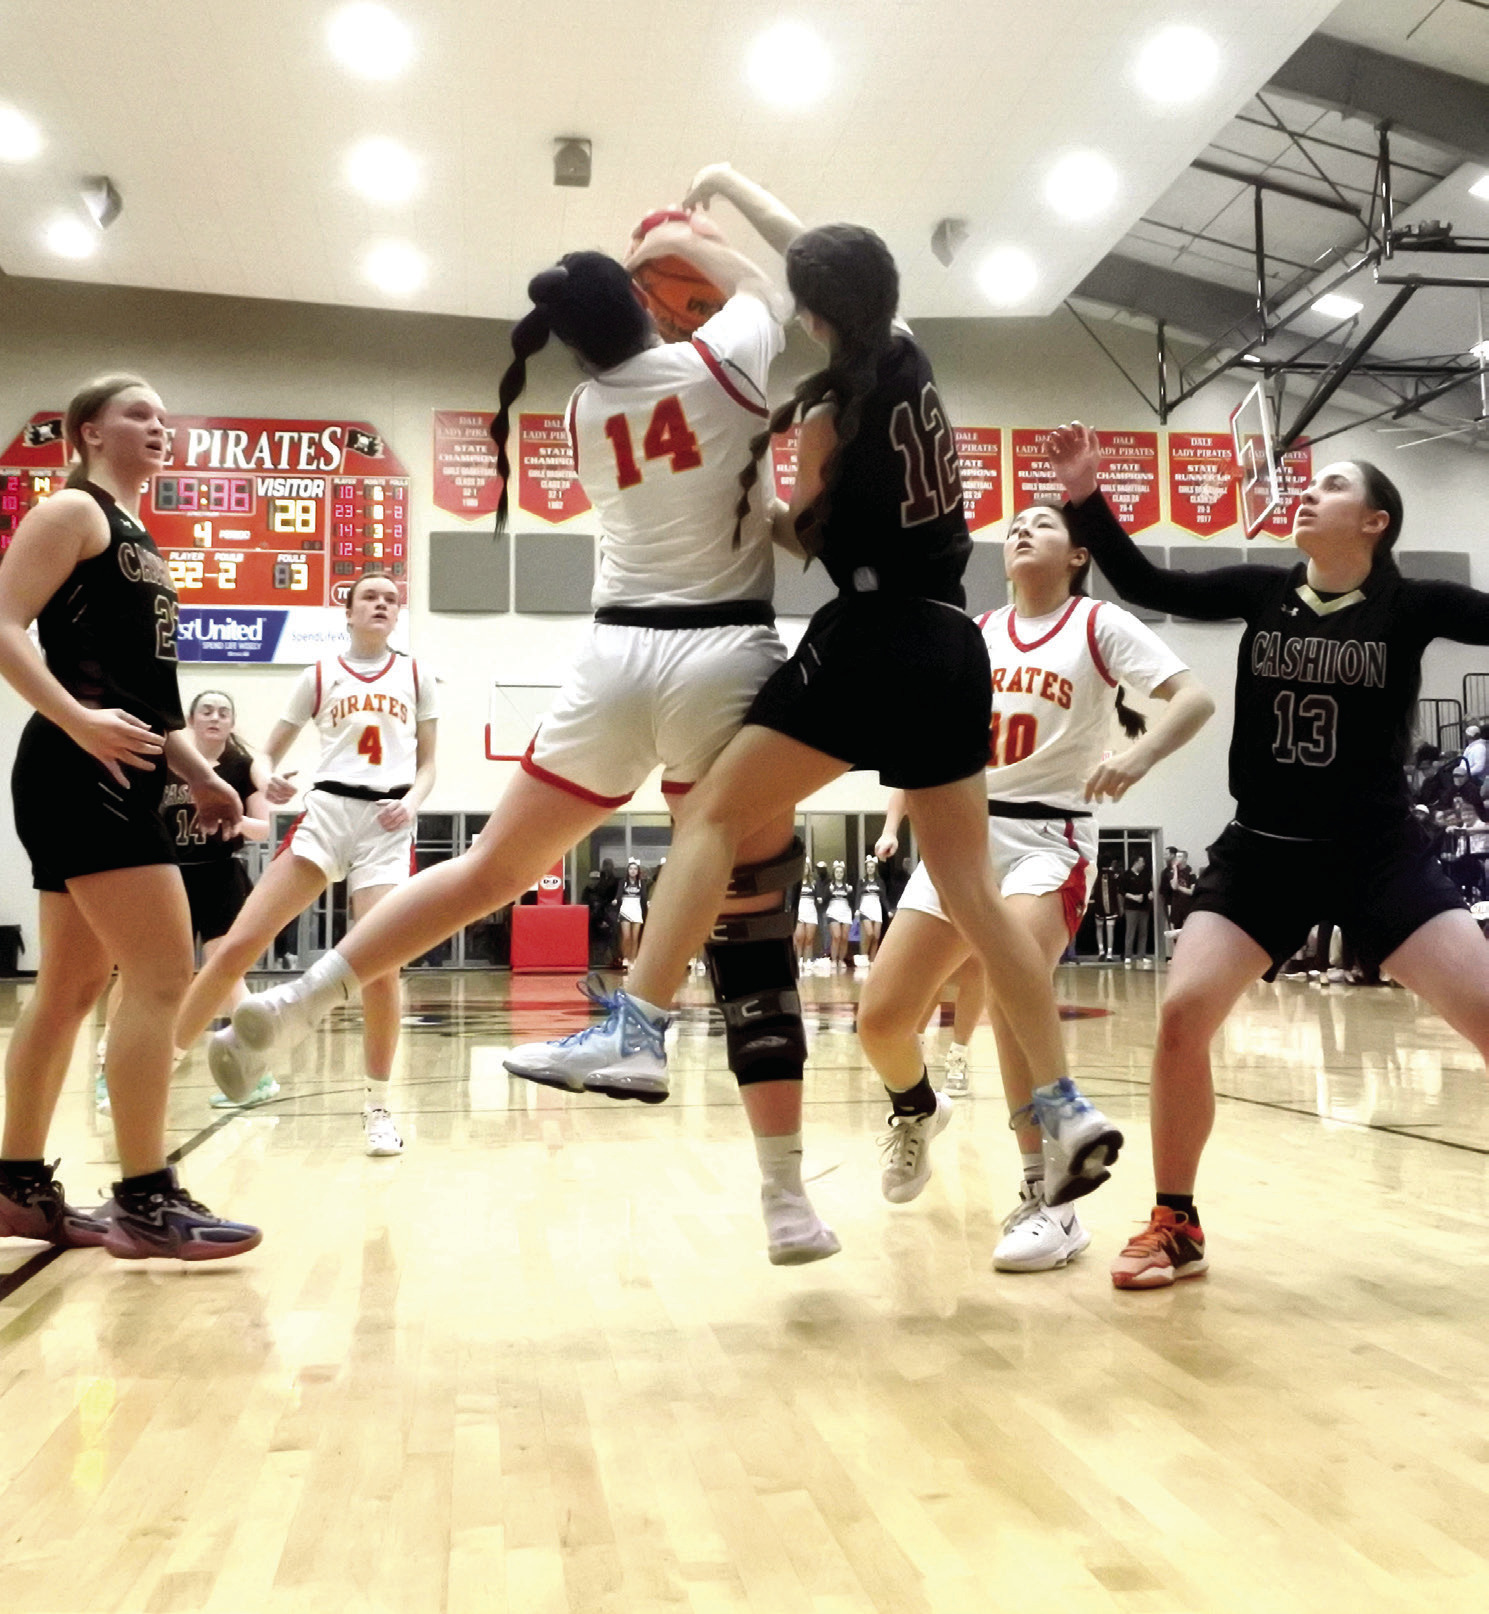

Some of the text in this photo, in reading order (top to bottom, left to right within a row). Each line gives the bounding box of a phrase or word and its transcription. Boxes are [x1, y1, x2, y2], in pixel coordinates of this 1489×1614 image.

[459, 416, 483, 425] DALE
[544, 419, 564, 428] DAL
[465, 428, 488, 437] PIRA
[523, 431, 546, 439] LADY
[956, 432, 978, 440] DALE
[604, 394, 703, 491] 14
[1113, 436, 1135, 445] DALE
[1190, 438, 1213, 446] DALE
[185, 426, 342, 471] PIRATES
[454, 445, 487, 453] STATE
[961, 444, 998, 452] PIRATES
[1016, 445, 1039, 453] LADY
[1100, 447, 1155, 456] ADY PIRATES
[1172, 448, 1232, 457] LADY PIRATES
[439, 455, 498, 463] CHAMPION
[889, 382, 963, 528] 12
[1248, 450, 1265, 458] LAD
[960, 459, 983, 467] TATE
[1031, 461, 1050, 469] STA
[1109, 463, 1140, 471] STATE
[1096, 472, 1154, 480] CHAMPIONS
[257, 478, 325, 498] VISITOR
[340, 486, 353, 498] 10
[274, 499, 317, 533] 28
[335, 505, 353, 518] 23
[194, 521, 212, 548] 4
[340, 524, 353, 537] 14
[374, 523, 384, 538] 3
[340, 543, 353, 556] 12
[374, 542, 384, 557] 3
[169, 552, 205, 561] PLAYER
[277, 553, 307, 563] FOULS
[291, 563, 308, 590] 3
[155, 594, 179, 660] 2
[178, 617, 263, 641] stUnited
[1251, 630, 1387, 688] CASHION
[991, 665, 1073, 711] RATES
[330, 693, 408, 728] PIRATES
[1272, 690, 1339, 767] 13
[357, 724, 383, 766] 4
